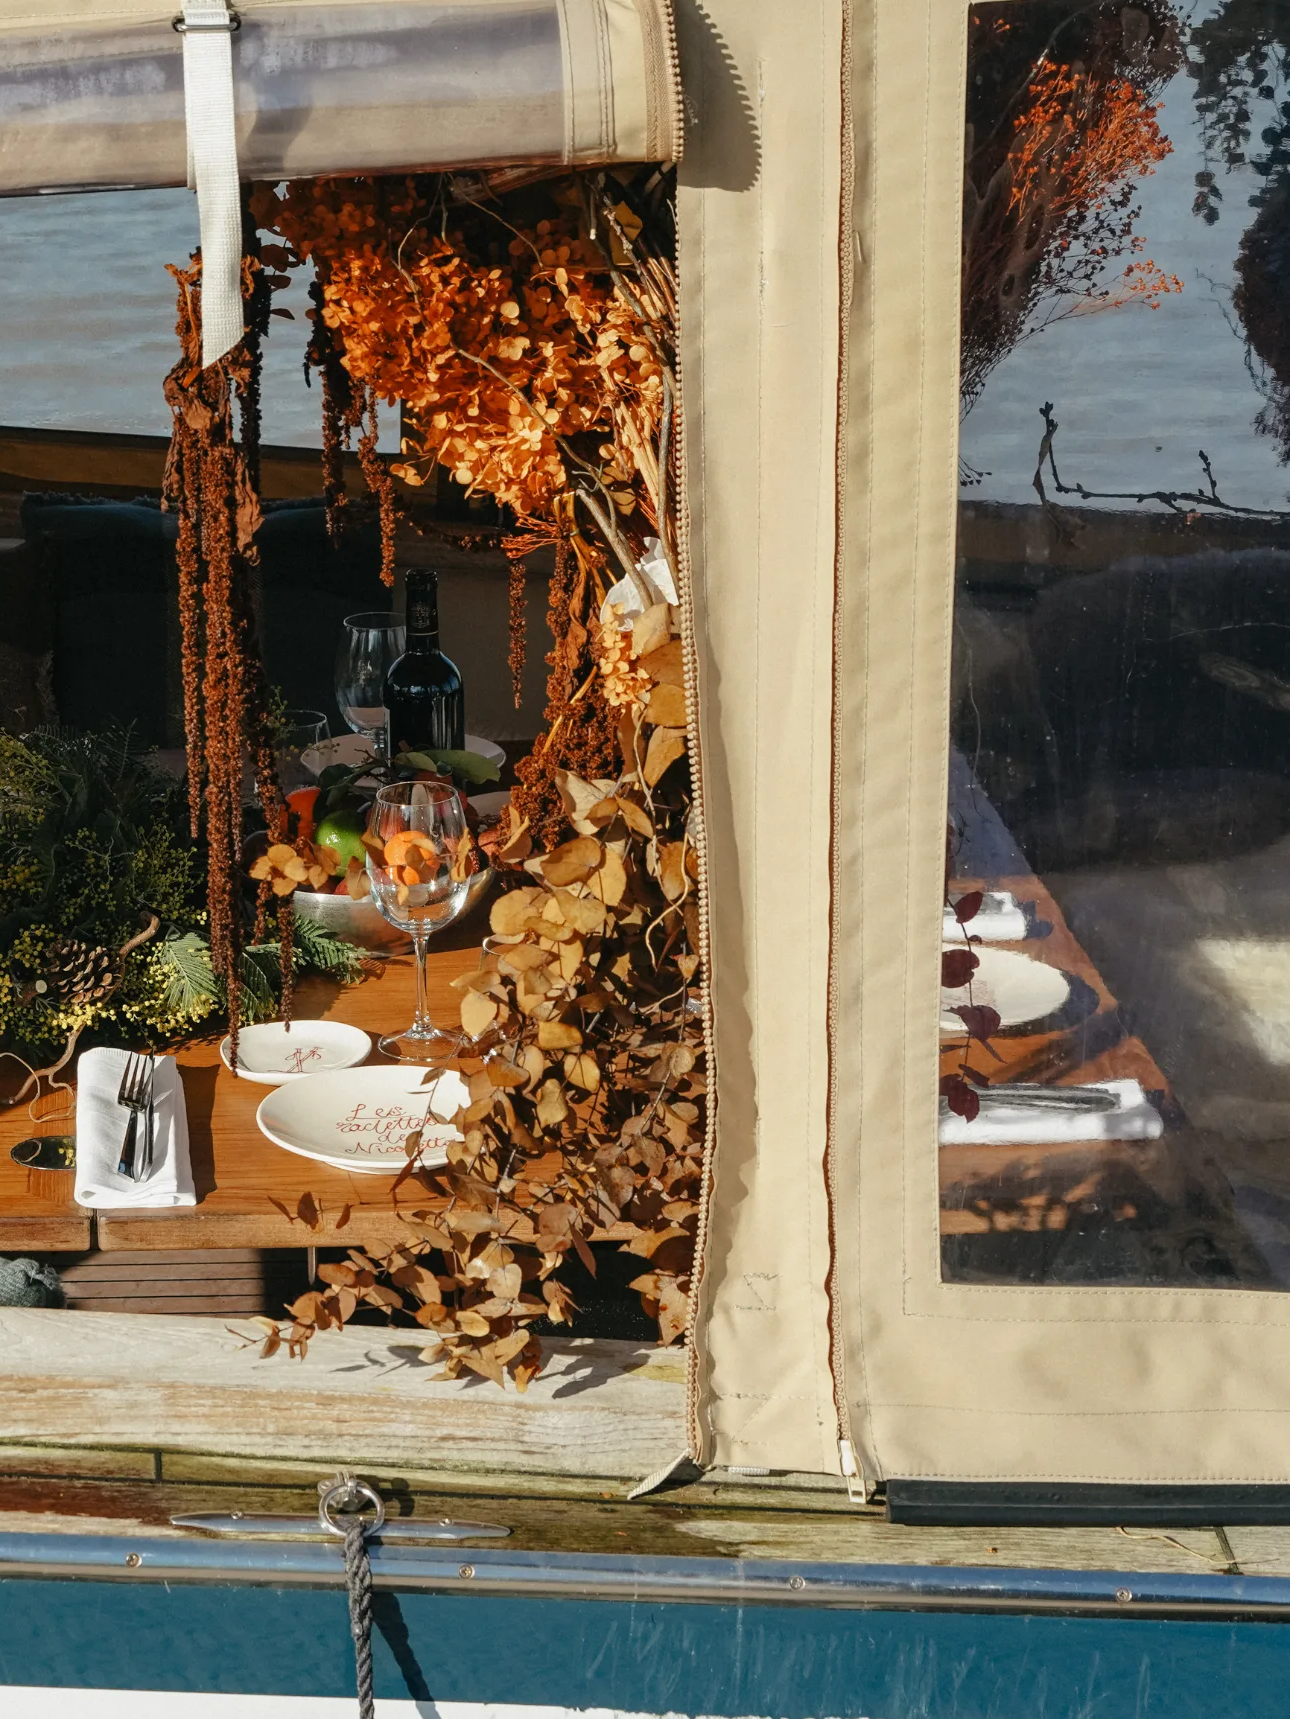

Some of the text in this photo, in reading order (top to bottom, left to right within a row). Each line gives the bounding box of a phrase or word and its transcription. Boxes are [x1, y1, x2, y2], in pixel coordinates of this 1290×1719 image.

[346, 1104, 407, 1121] Les
[344, 1137, 454, 1154] Nicoette
[378, 1131, 407, 1144] de
